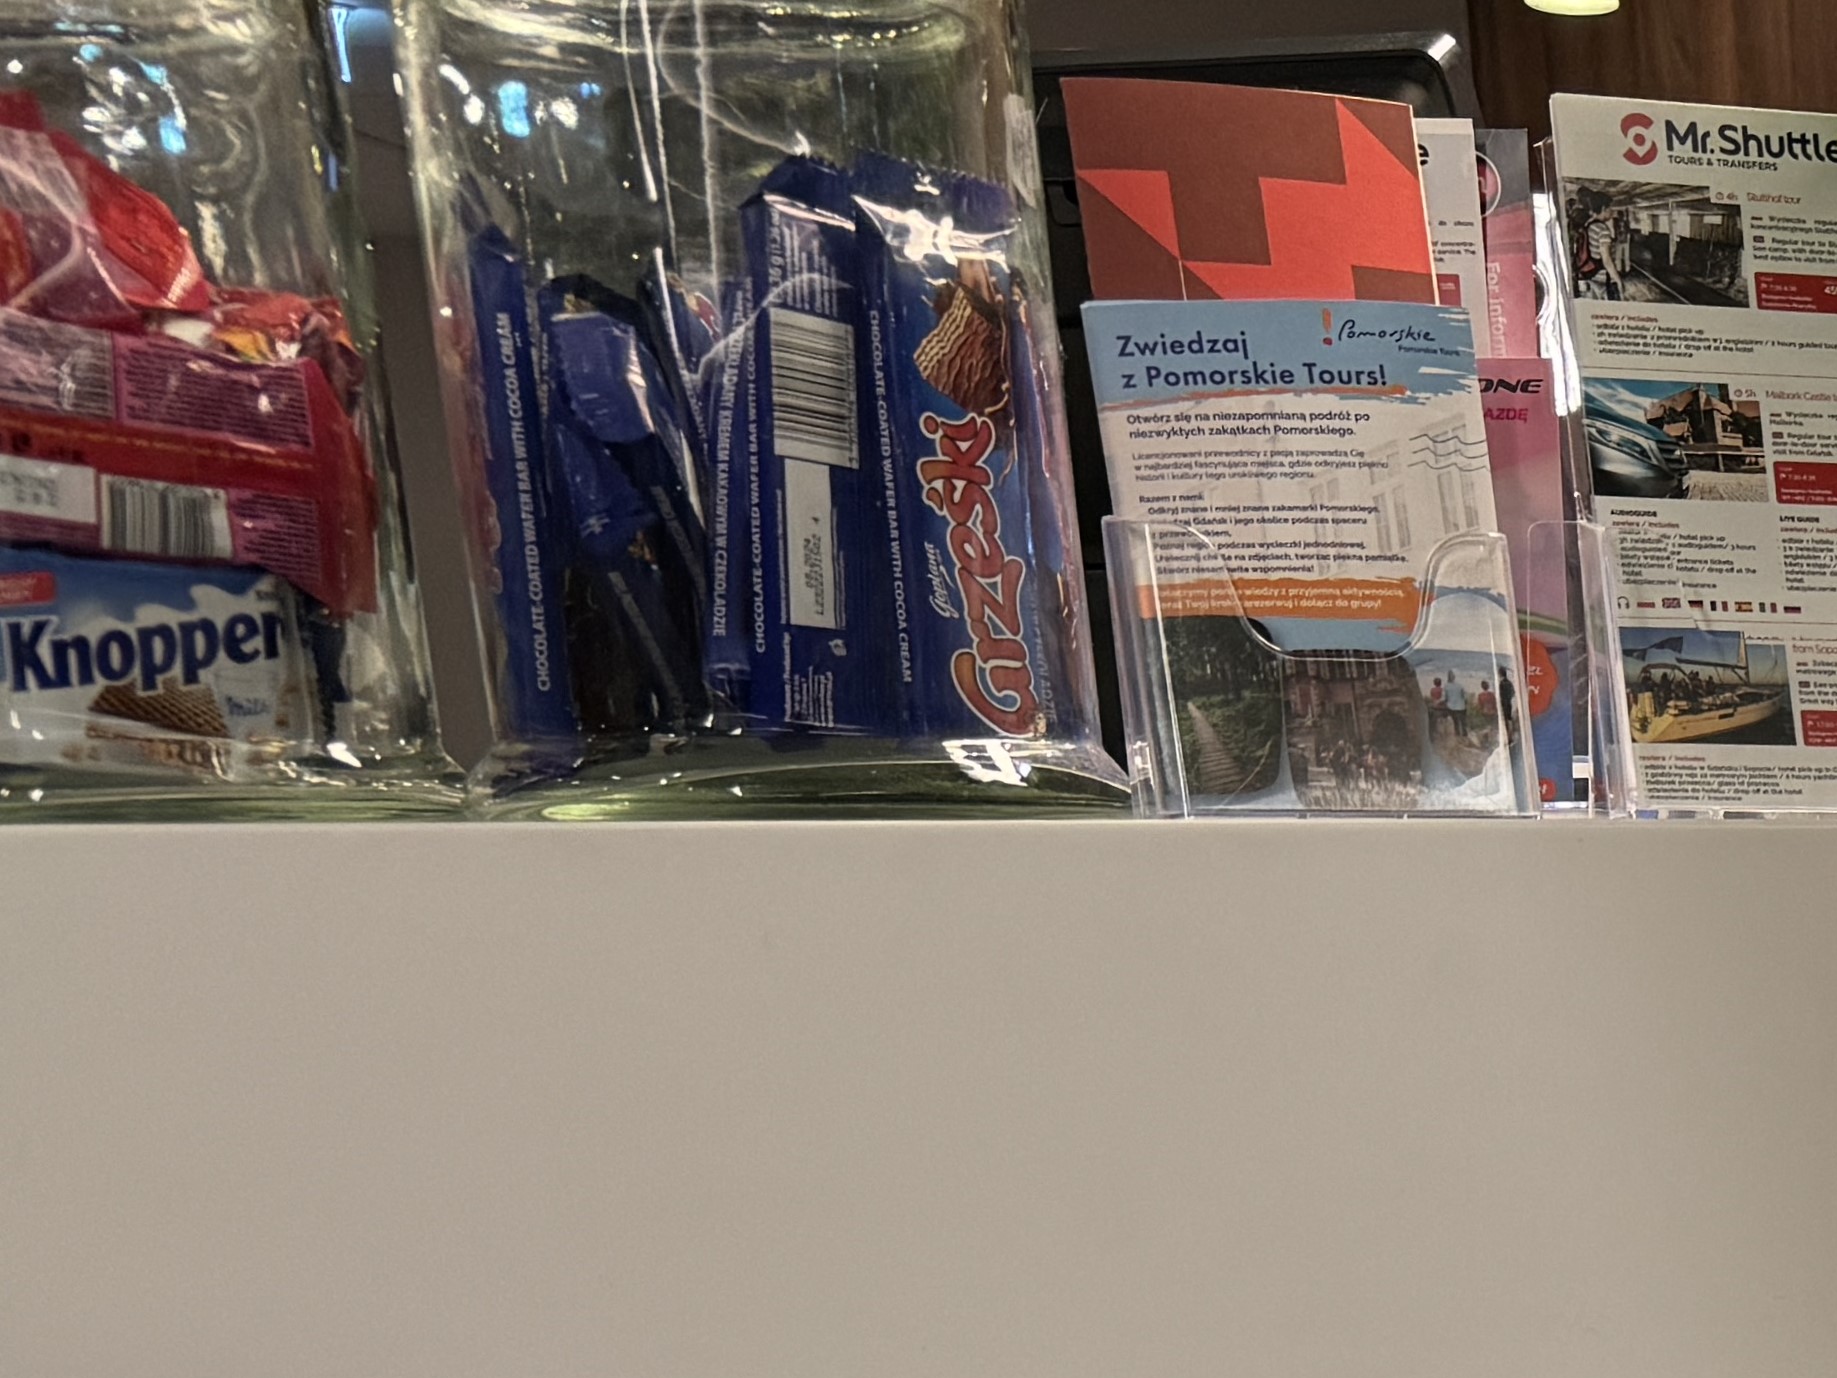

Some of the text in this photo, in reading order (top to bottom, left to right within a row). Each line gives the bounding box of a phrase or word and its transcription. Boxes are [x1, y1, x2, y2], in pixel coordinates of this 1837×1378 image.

[1668, 155, 1778, 171] TOURS TRANSFERS
[1117, 331, 1250, 360] Zwiedzaj
[1337, 319, 1436, 343] Pomorskie
[1121, 363, 1388, 389] z Pomorskie Tours!
[504, 367, 522, 418] COCOA
[1126, 410, 1370, 425] Otwórz się na niezapomnianą podróż po
[870, 310, 908, 630] CHOCOLATE-COATED COCOA
[916, 409, 1040, 738] Grześki
[6, 611, 282, 693] Knopper
